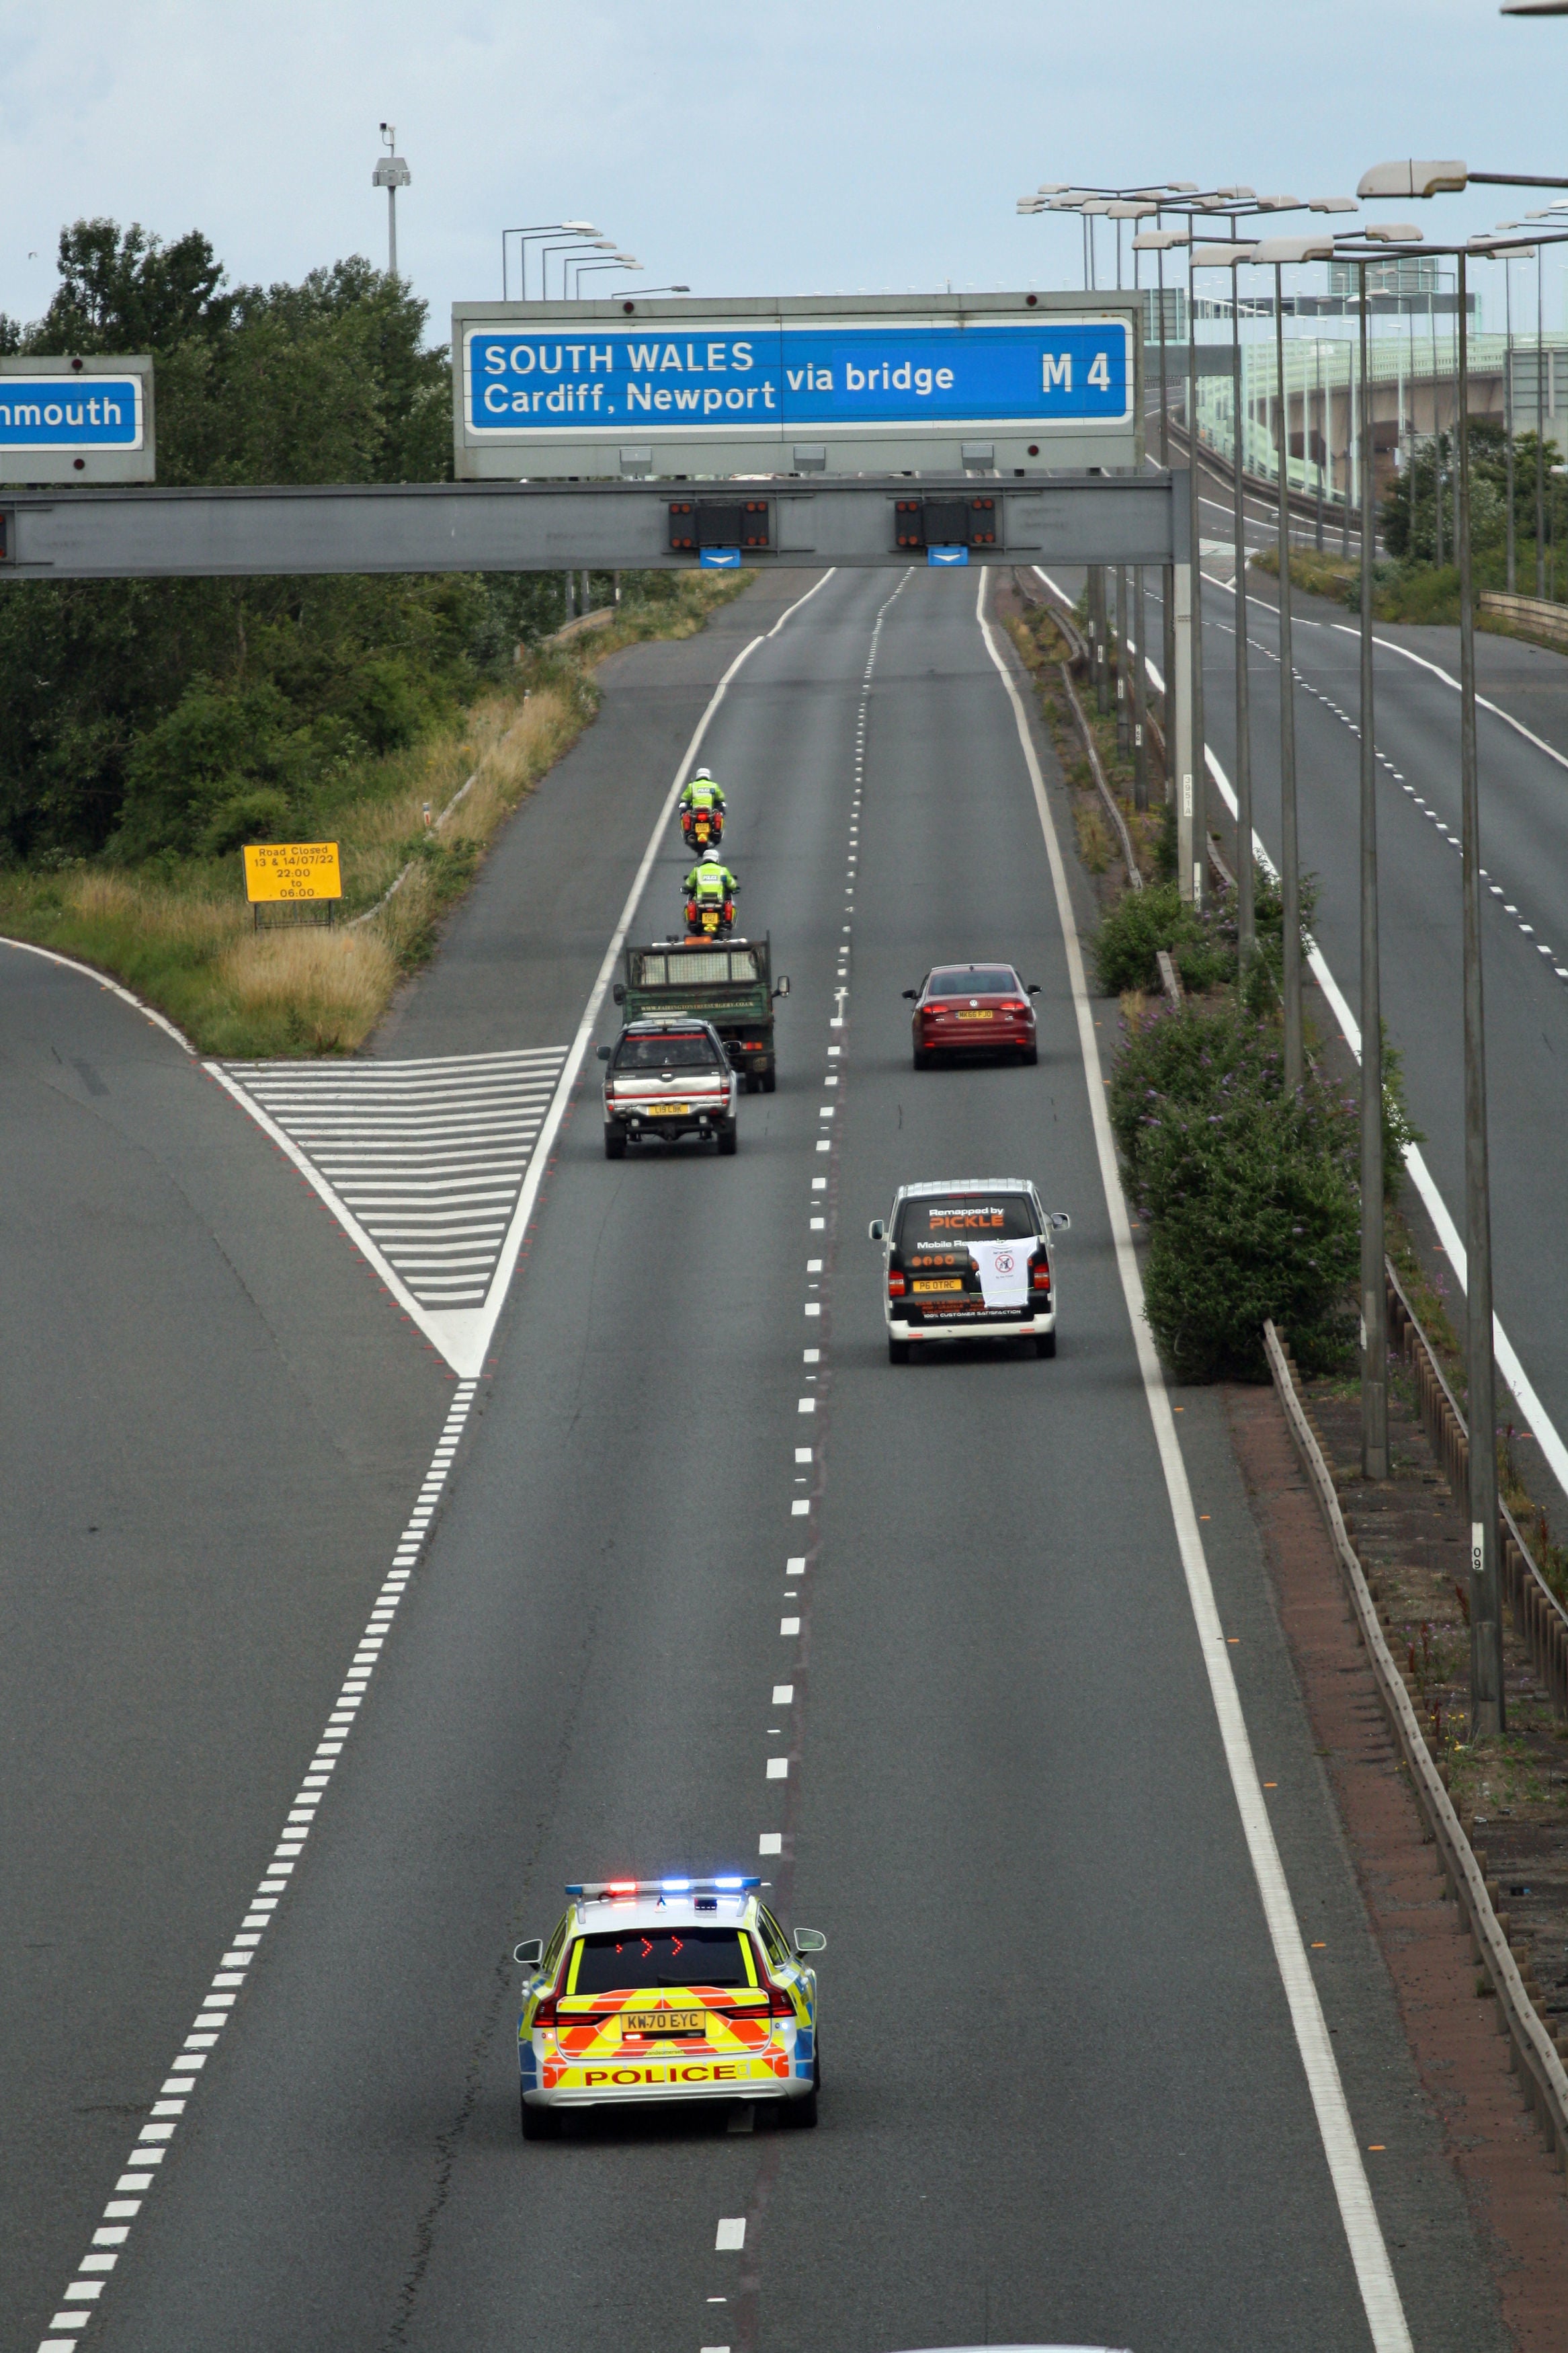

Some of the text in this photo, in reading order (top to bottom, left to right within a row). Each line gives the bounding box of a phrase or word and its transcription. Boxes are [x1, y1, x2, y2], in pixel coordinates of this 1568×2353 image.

[485, 342, 753, 375] SOUTH WALES
[786, 361, 954, 395] via bridge
[484, 379, 776, 415] Cardiff, Newport
[259, 845, 327, 856] Road Closed
[254, 854, 333, 867] 13 & 14/07/22
[276, 869, 311, 877] 22:00
[290, 879, 302, 887] to
[280, 888, 315, 898] 06:00
[929, 1207, 1004, 1216] Remapped by
[929, 1214, 1005, 1230] PICKLE
[917, 1240, 952, 1249] Mobile
[919, 1281, 930, 1289] P6
[628, 2013, 698, 2029] KW70 EYC
[585, 2065, 737, 2086] POLICE
